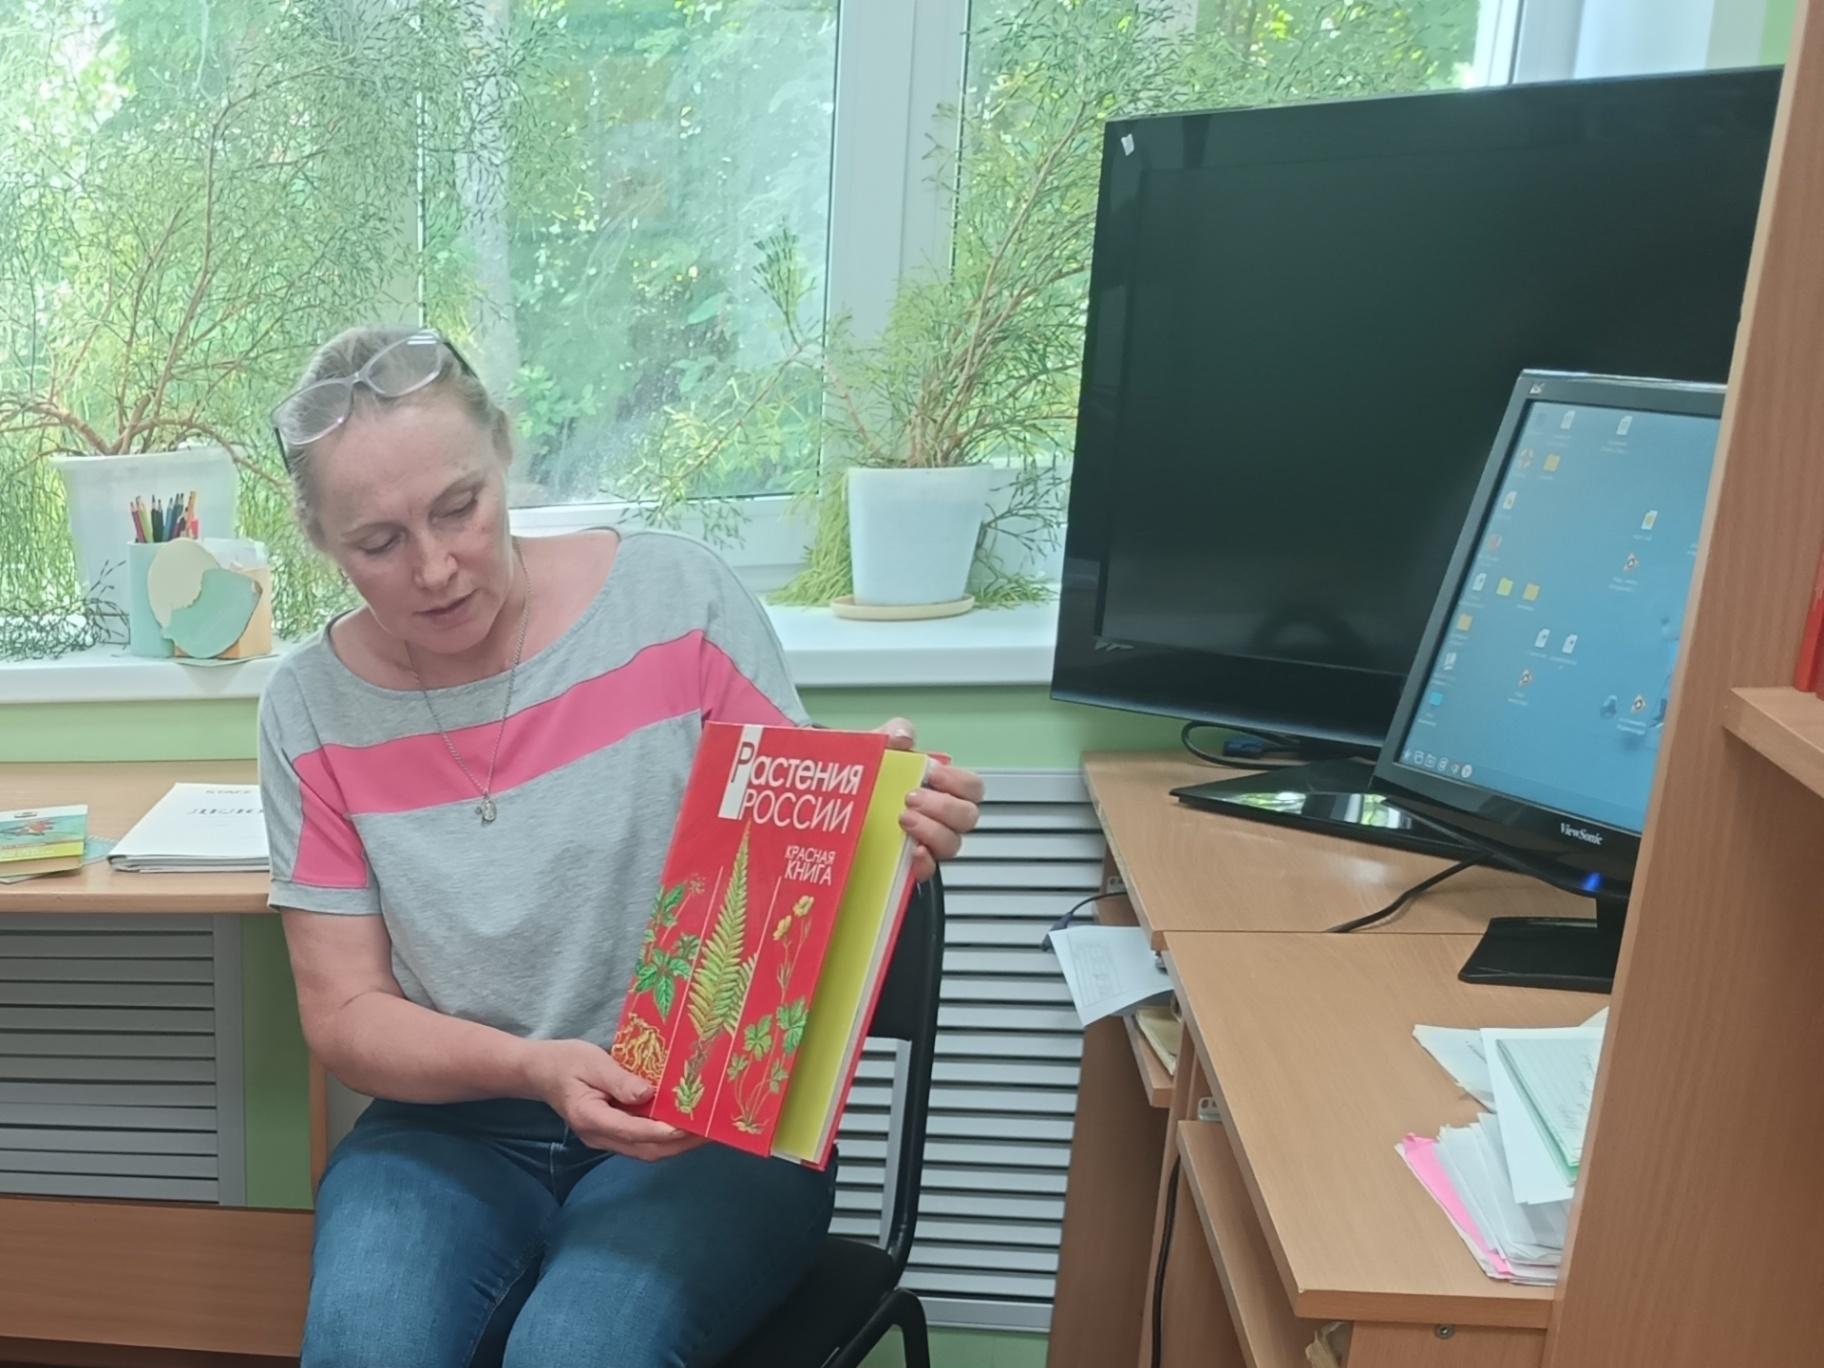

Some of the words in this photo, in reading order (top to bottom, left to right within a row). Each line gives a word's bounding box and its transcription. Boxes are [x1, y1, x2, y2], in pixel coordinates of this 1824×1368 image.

[731, 741, 865, 796] Растения
[738, 788, 855, 835] РОССИИ
[1560, 822, 1603, 845] ViewSonic
[784, 845, 837, 866] КРАСНАЯ
[784, 859, 833, 887] КНИГА
